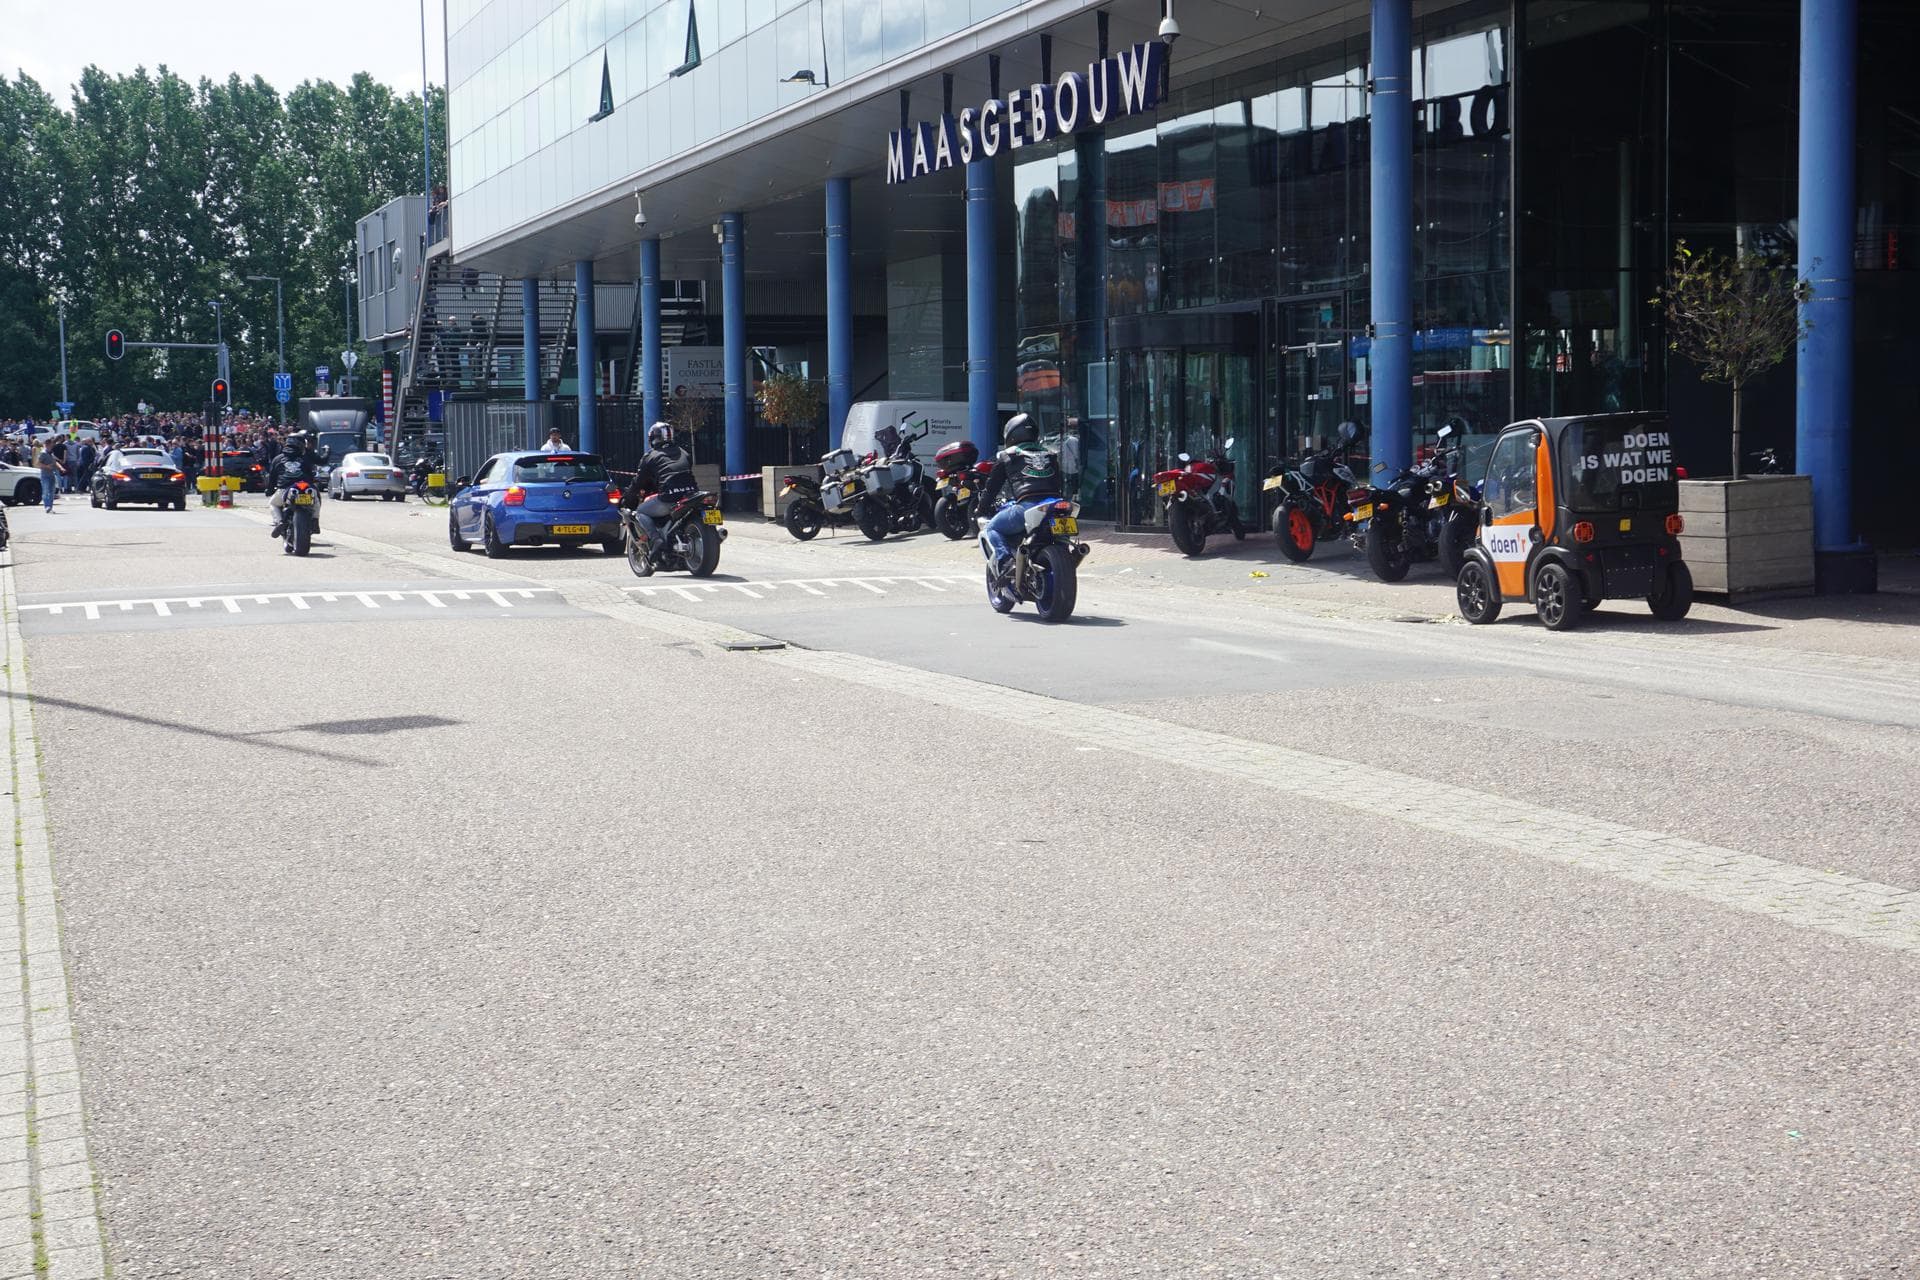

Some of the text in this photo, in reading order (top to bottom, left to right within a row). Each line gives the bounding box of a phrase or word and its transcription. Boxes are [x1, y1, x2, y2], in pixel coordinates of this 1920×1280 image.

[886, 41, 1163, 184] MAASGEBOUW
[678, 369, 721, 377] COMFORT
[687, 359, 724, 369] FASTLA
[1624, 432, 1669, 449] DOEN
[1580, 449, 1672, 470] IS WAT WE
[1490, 532, 1527, 554] doen'r
